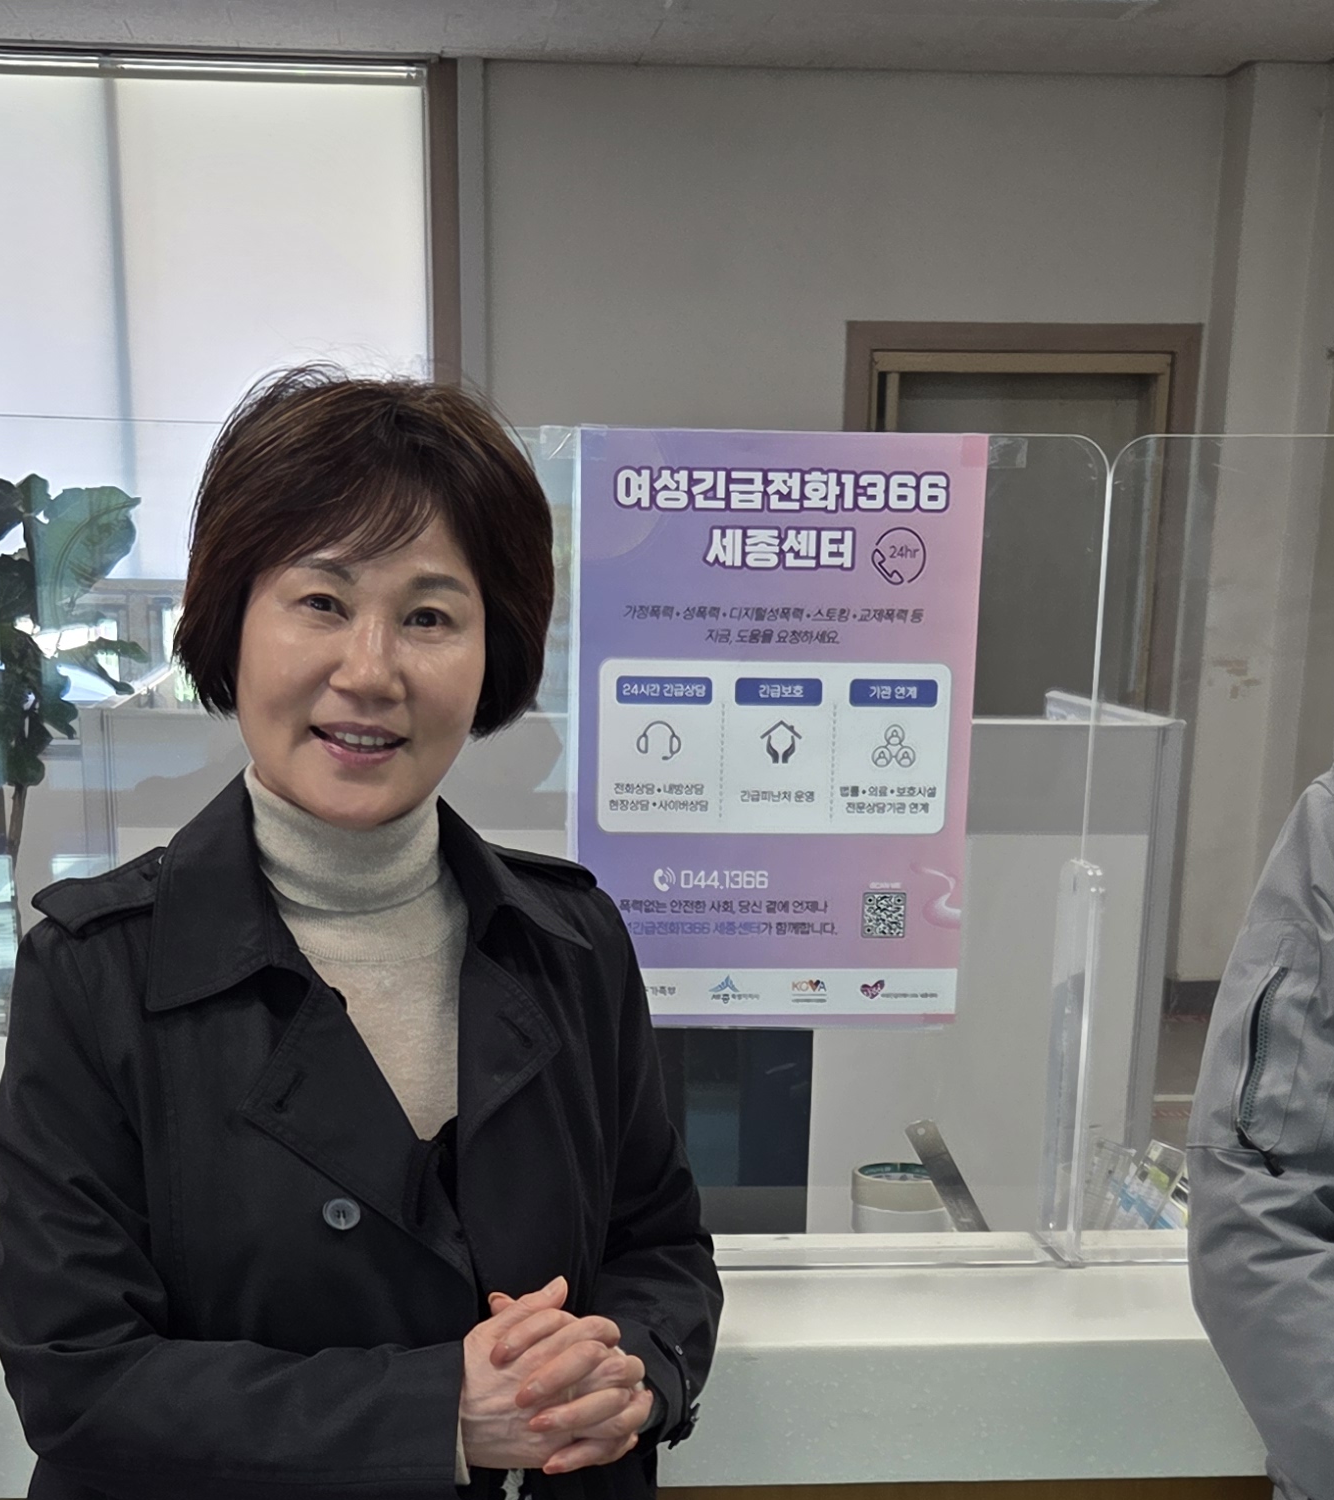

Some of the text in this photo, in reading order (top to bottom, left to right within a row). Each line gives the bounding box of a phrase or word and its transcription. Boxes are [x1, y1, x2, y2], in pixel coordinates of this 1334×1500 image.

[616, 468, 948, 511] 여성긴급전화1366
[706, 528, 854, 568] 세종센터
[889, 544, 920, 559] 24hr
[623, 605, 675, 620] 가정폭력
[682, 606, 721, 620] 성폭력
[857, 608, 909, 623] 교제폭력
[910, 609, 924, 624] 등
[735, 629, 774, 644] 도움을
[622, 683, 707, 698] 24시간 긴급상담
[758, 684, 805, 699] 긴급보호
[869, 686, 918, 700] 기관 연계
[613, 783, 656, 795] 전화상담
[740, 790, 815, 803] 긴급피난처 운영
[896, 786, 937, 798] 보호시설
[609, 799, 709, 812] 현장상담 사이버상담
[845, 802, 930, 814] 전문상담기관 연계
[680, 870, 769, 889] 044.1366
[670, 899, 707, 914] 안전한
[738, 900, 763, 914] 당신
[792, 900, 828, 914] 언제나
[628, 921, 711, 936] 긴급전화1366
